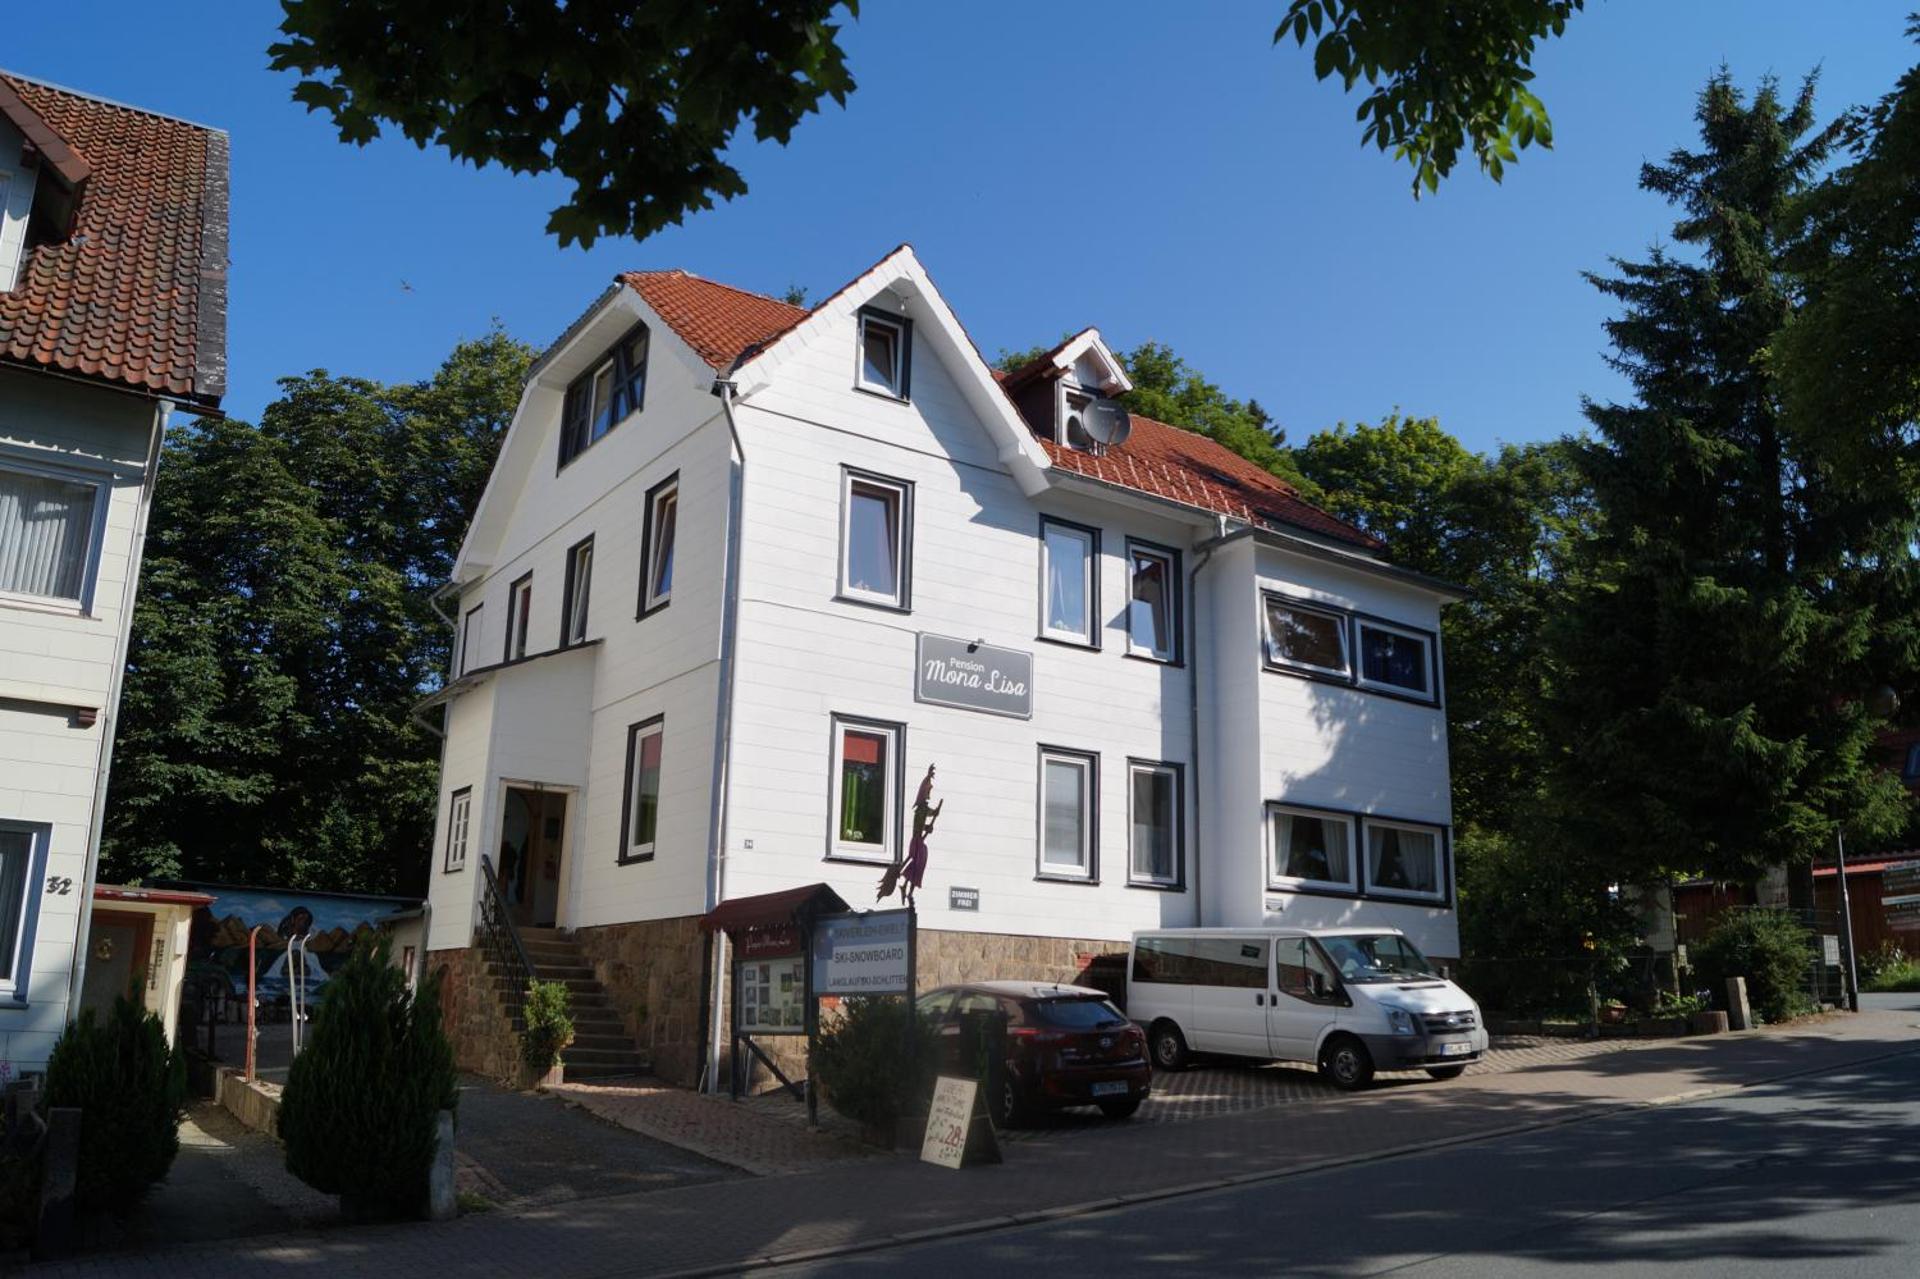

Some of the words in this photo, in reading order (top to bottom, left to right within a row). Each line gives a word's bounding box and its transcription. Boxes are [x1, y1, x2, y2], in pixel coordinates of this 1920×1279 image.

[949, 657, 985, 673] Pension
[925, 659, 982, 689] Mona
[984, 669, 1027, 697] Lisa
[46, 876, 73, 896] 32
[951, 890, 978, 900] ZIMMER
[957, 899, 972, 907] FREI
[834, 948, 904, 964] SKI-SNOWBOARD
